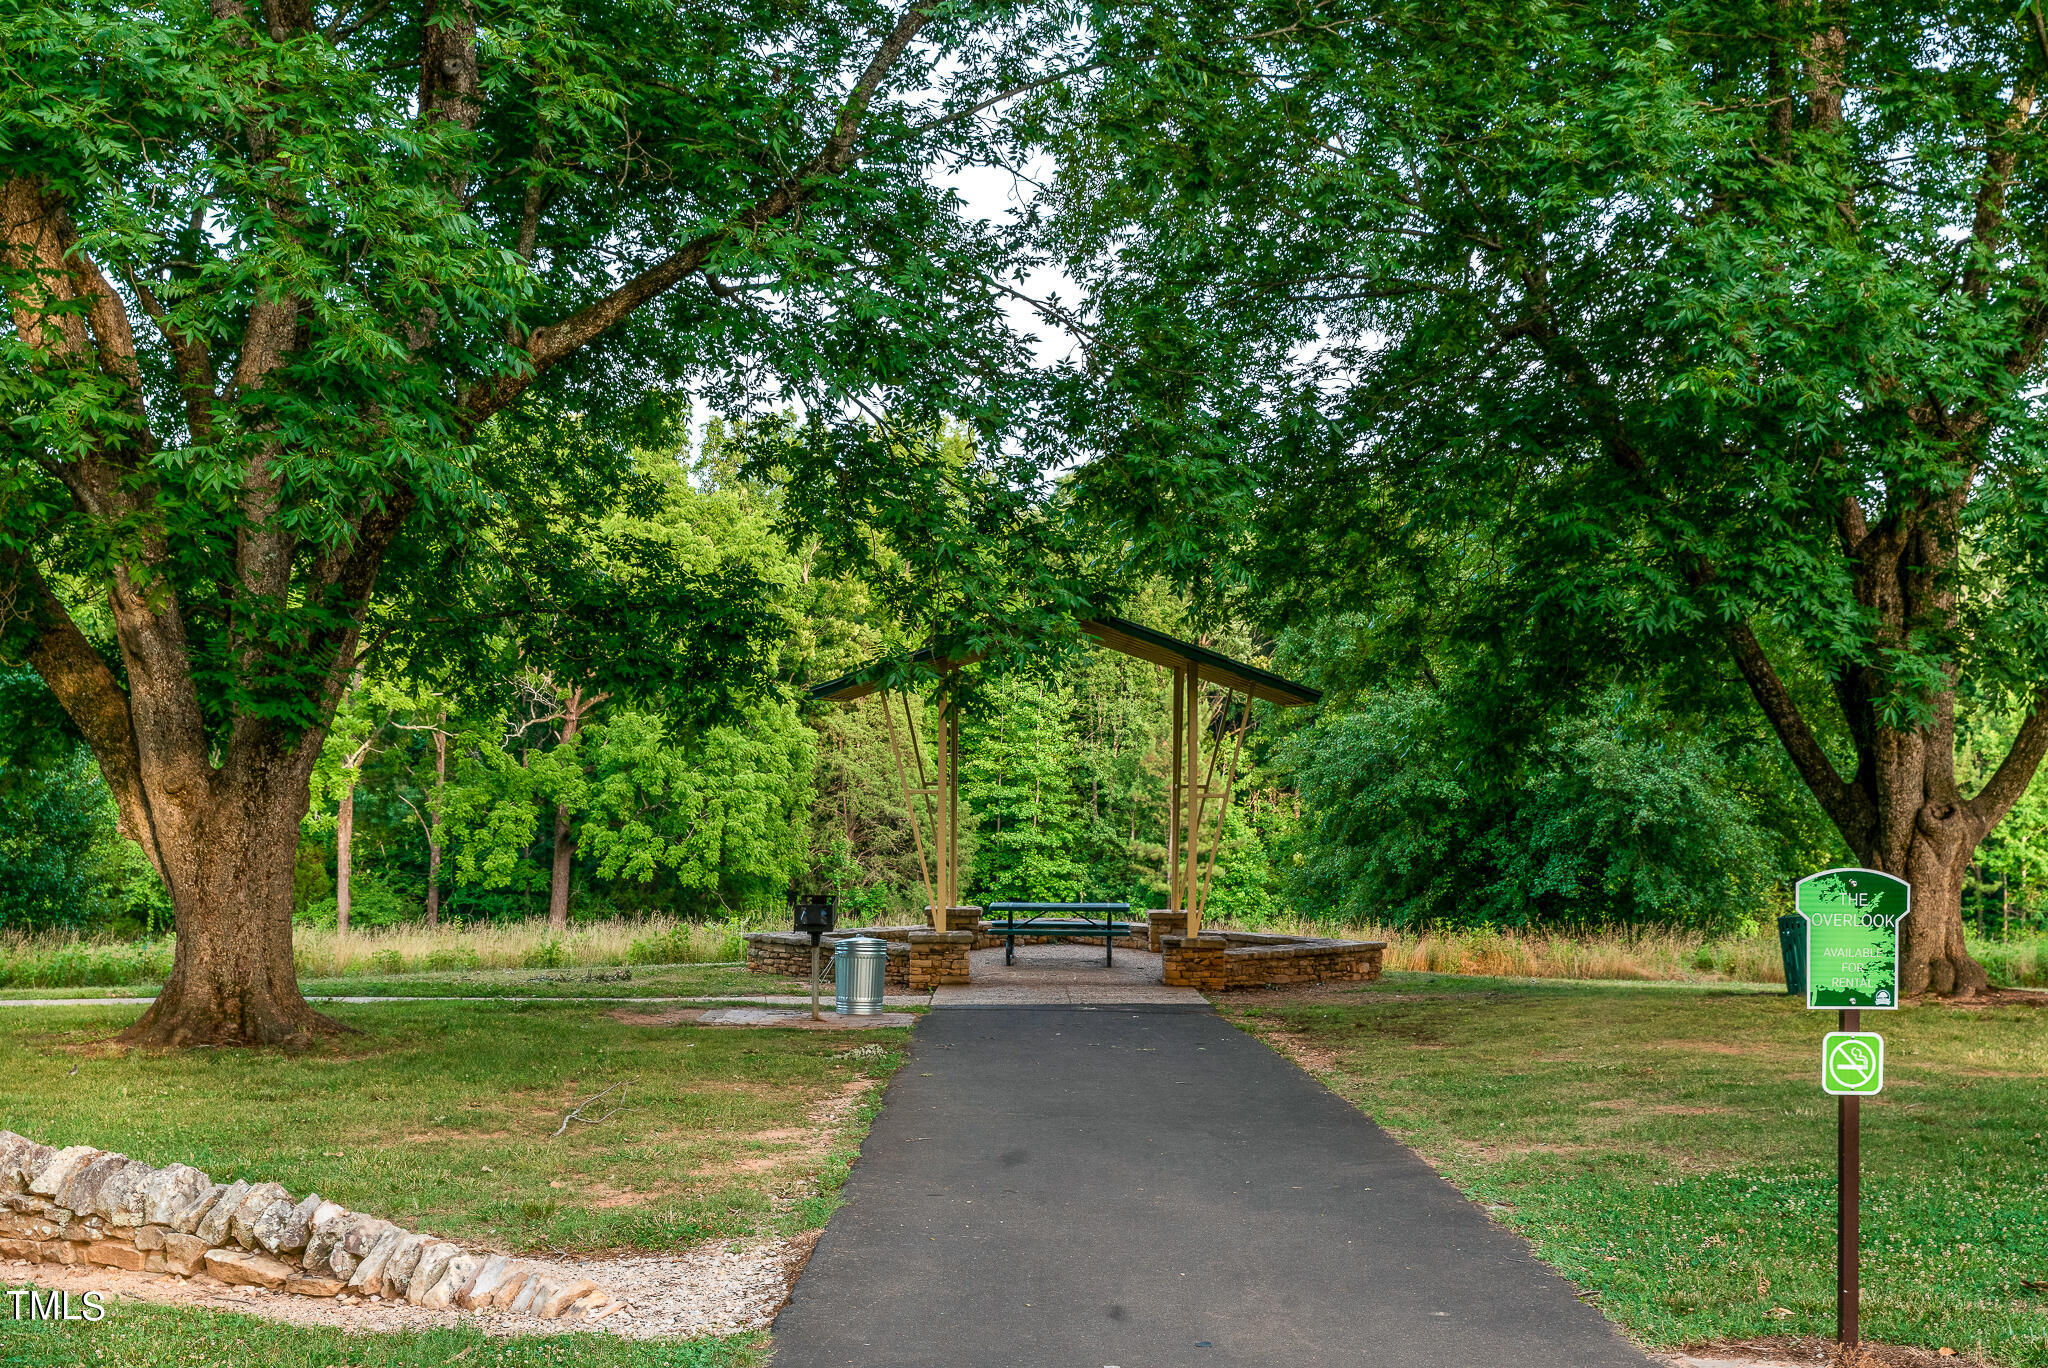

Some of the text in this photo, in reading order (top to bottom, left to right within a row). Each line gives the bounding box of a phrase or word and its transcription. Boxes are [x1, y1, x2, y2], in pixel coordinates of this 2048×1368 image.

[1839, 892, 1869, 906] THE
[1811, 913, 1895, 928] OVERLOOK
[1823, 947, 1884, 958] AVAILABLE
[1841, 962, 1864, 973] FOR
[1831, 977, 1874, 988] RENTAL
